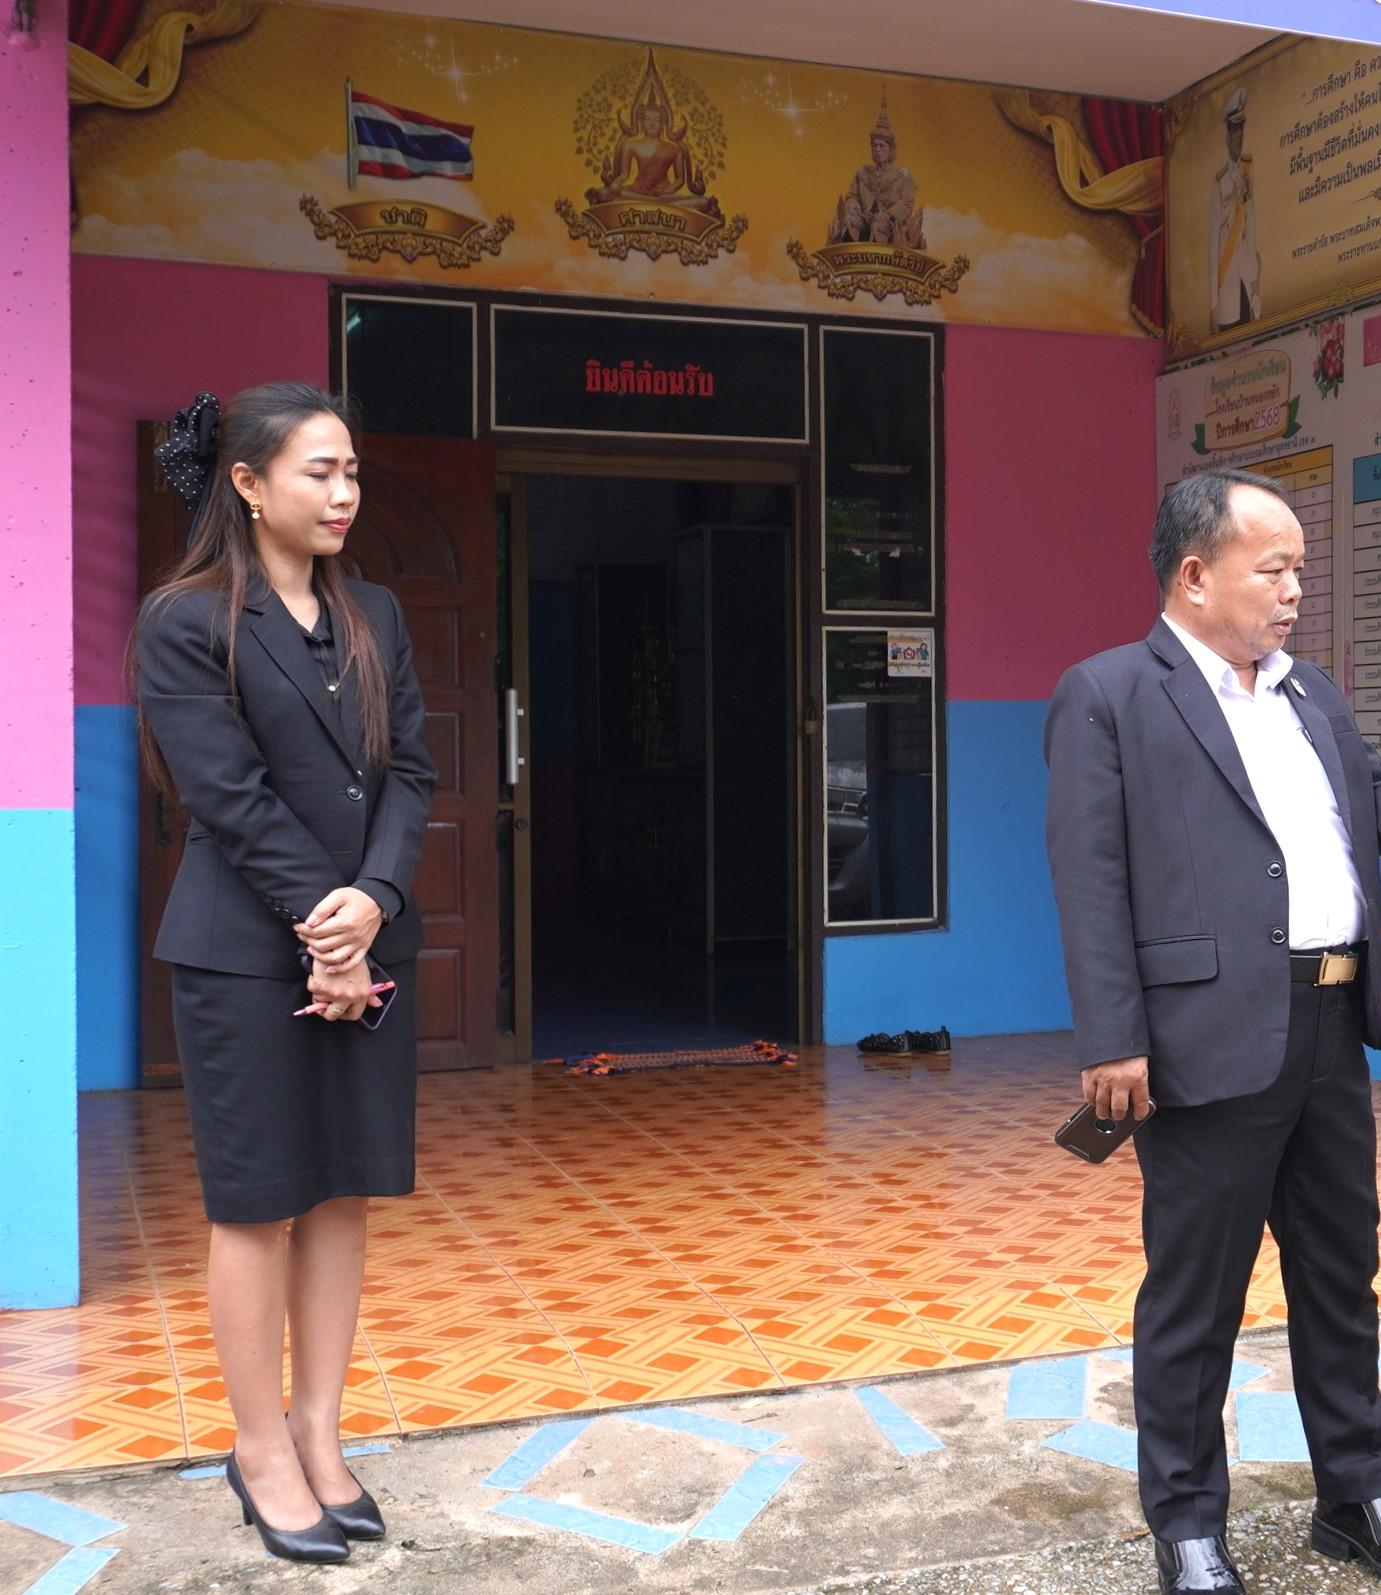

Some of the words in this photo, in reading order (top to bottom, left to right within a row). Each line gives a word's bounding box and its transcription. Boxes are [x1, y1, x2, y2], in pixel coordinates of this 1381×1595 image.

[380, 205, 428, 228] ชาติ
[619, 207, 687, 231] ศาสนา
[585, 358, 714, 396] ยินดีต้อนรับ
